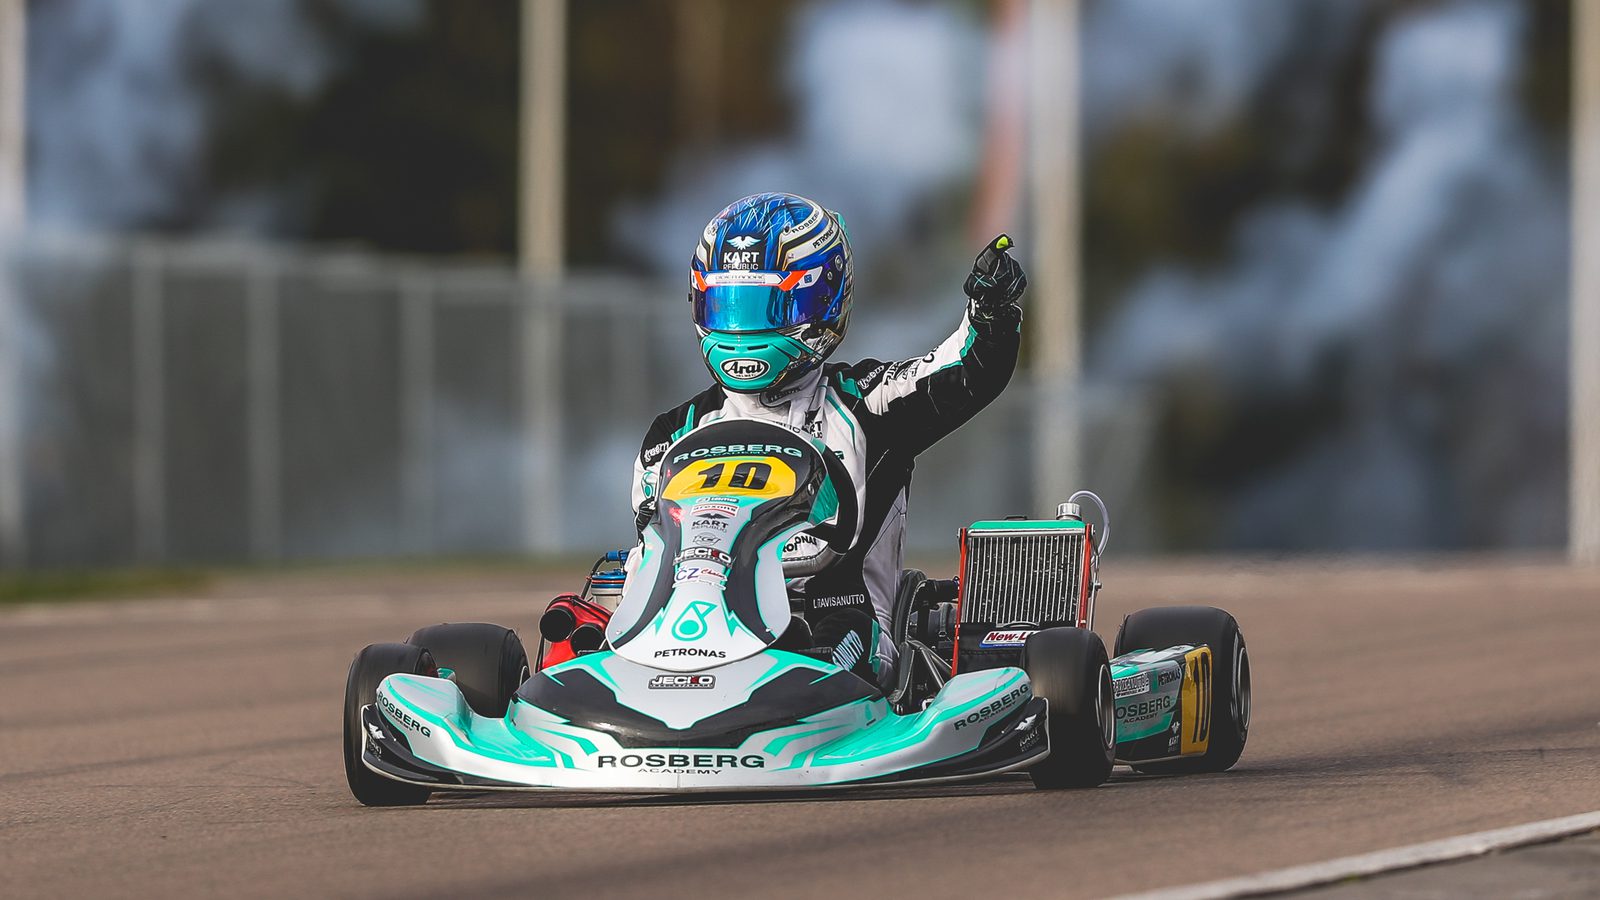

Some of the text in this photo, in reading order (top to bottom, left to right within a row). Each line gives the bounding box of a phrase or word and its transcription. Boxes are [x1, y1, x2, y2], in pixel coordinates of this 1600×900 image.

[812, 229, 834, 249] PETRONAS
[723, 251, 760, 263] KART
[724, 360, 764, 375] Arai
[672, 444, 803, 465] ROSBERG
[697, 462, 772, 491] 10
[692, 519, 729, 529] KART
[654, 648, 727, 659] PETRONAS
[953, 683, 1030, 731] ROSBERG
[1115, 695, 1171, 720] OSBERG
[1191, 651, 1209, 744] 10
[377, 690, 432, 738] ROSBERG
[1123, 712, 1158, 724] ACADEMY
[597, 754, 765, 769] ROSBERG
